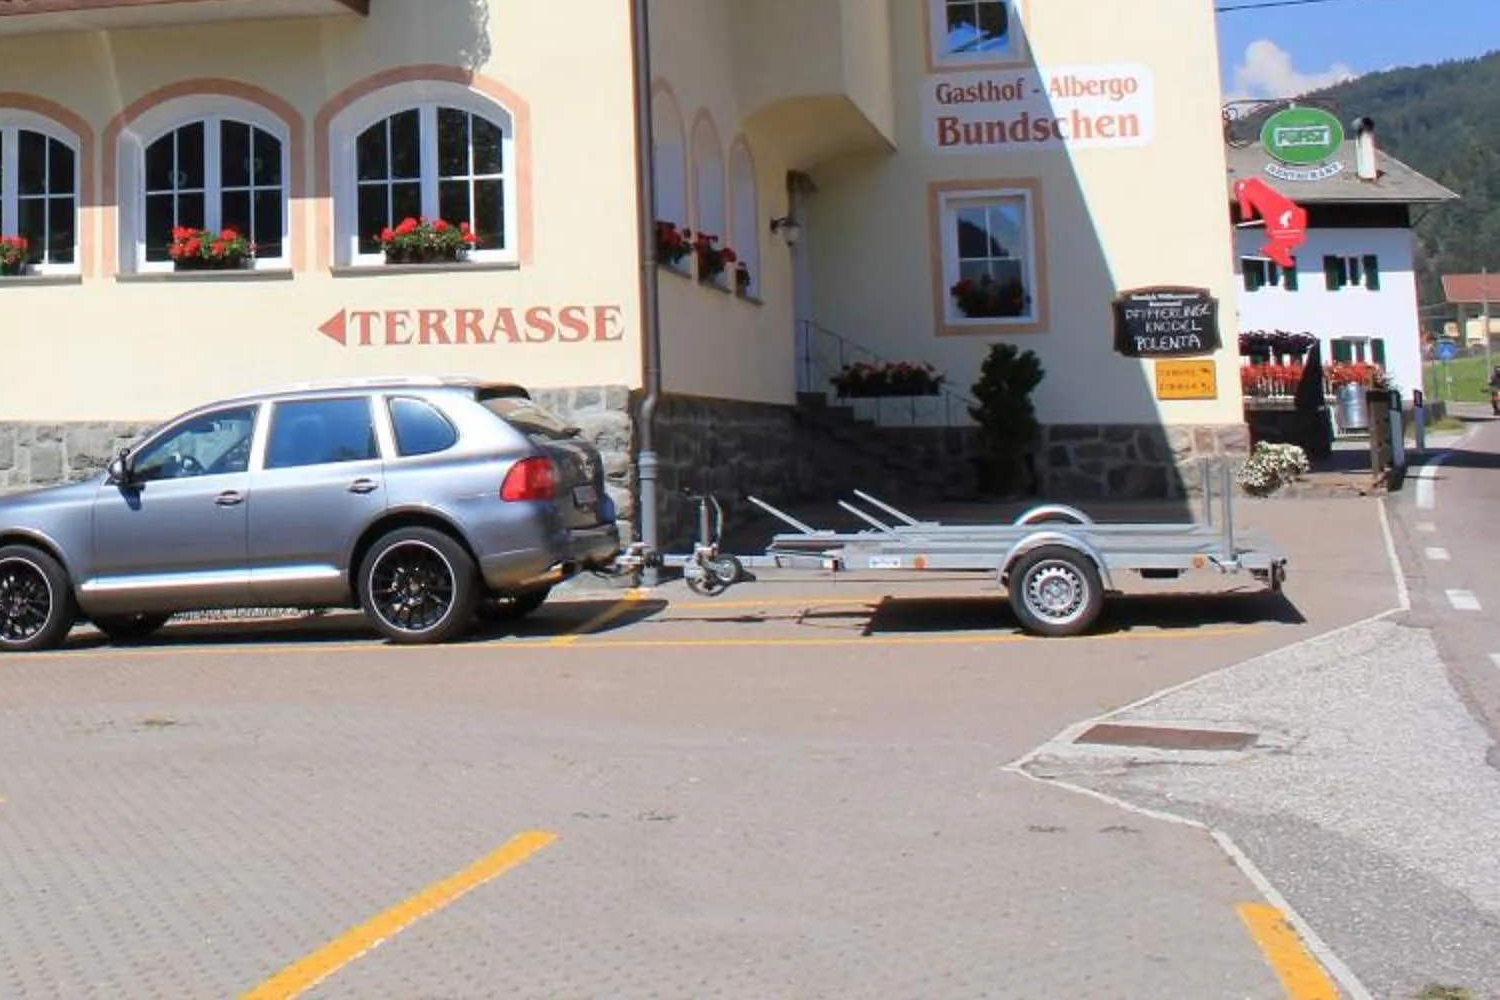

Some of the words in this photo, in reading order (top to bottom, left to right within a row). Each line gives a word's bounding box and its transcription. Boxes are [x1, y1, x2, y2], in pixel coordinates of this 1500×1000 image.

[935, 77, 1025, 105] Gasthof
[1050, 75, 1138, 101] Albergo
[936, 109, 1140, 147] Bundschen
[350, 305, 625, 346] TERRASSE
